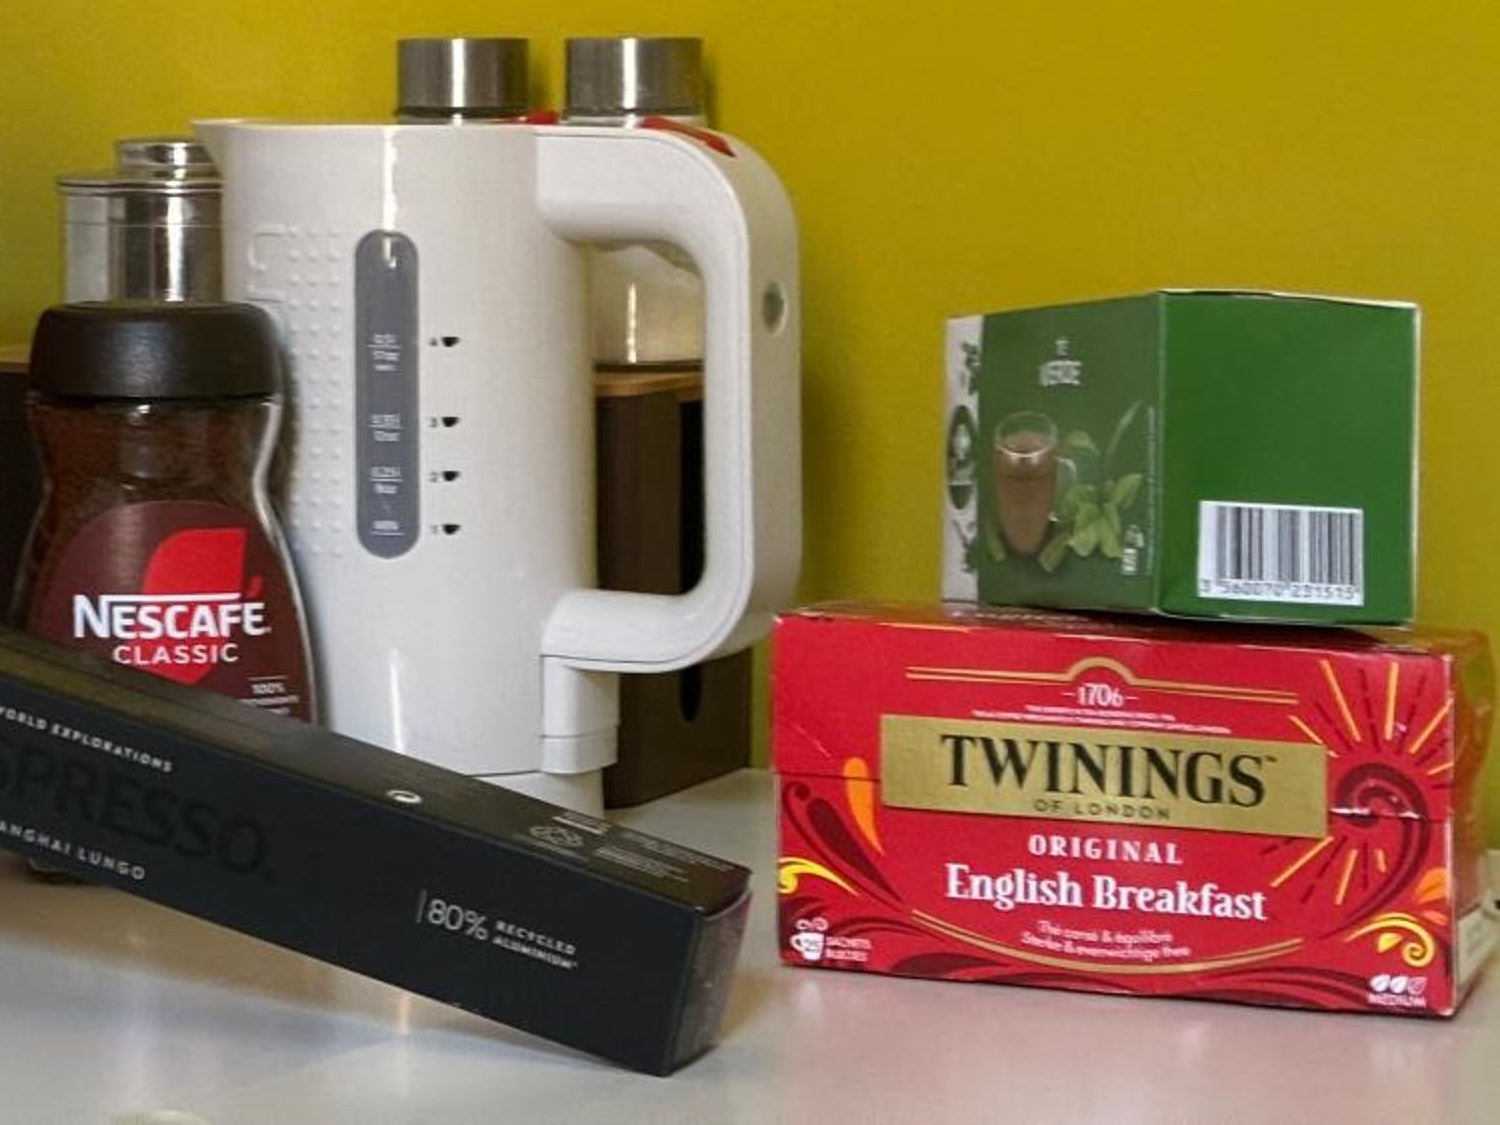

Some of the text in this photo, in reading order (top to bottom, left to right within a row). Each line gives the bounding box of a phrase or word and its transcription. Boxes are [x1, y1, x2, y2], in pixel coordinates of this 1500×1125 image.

[73, 578, 272, 637] NESCAFÉ
[112, 643, 239, 665] CLASSIC
[1076, 682, 1125, 707] 1706
[51, 722, 174, 773] EXPLORATIONS
[1033, 798, 1171, 820] OF LONDON
[78, 846, 146, 881] LUNGO
[1027, 834, 1183, 865] ORIGINAL
[944, 862, 1268, 921] English Breakfast
[427, 897, 488, 941] 80%
[496, 919, 578, 957] RECYCLED
